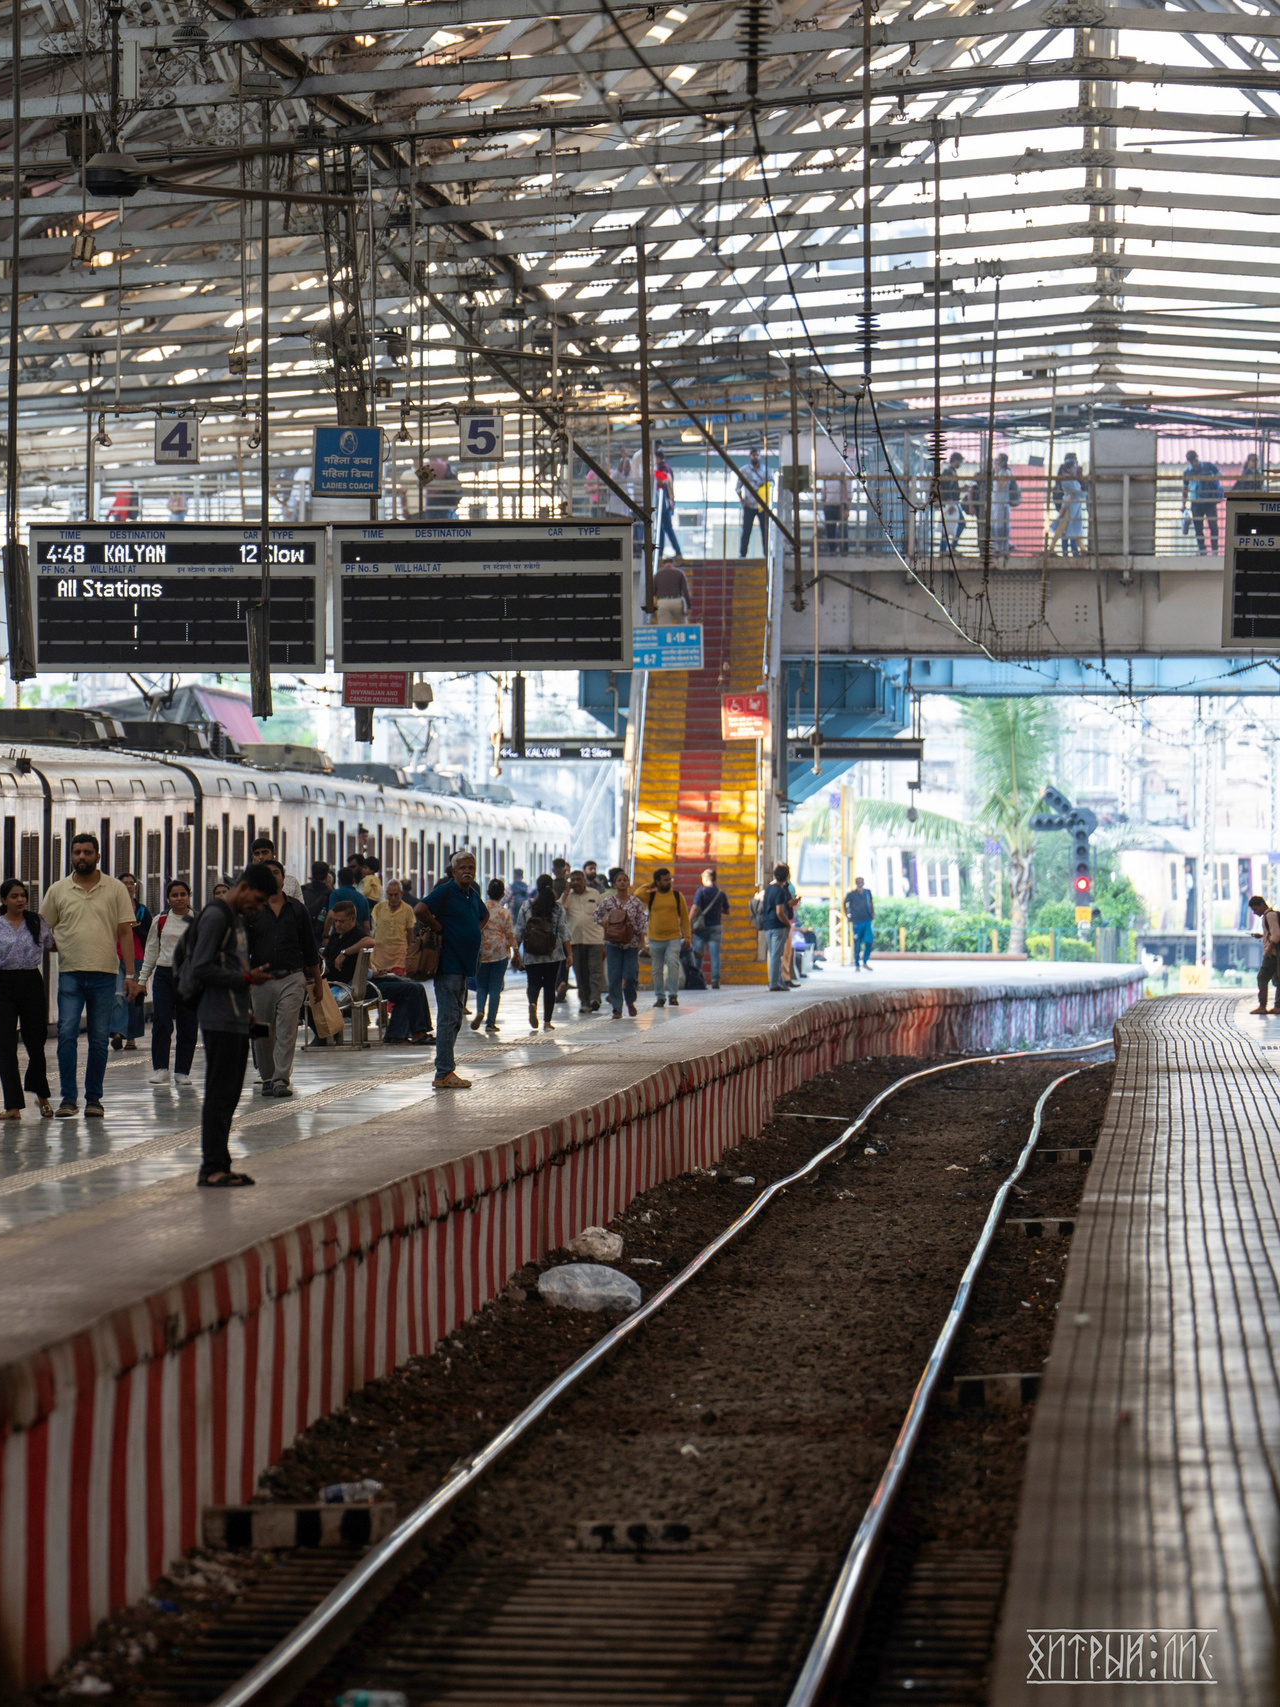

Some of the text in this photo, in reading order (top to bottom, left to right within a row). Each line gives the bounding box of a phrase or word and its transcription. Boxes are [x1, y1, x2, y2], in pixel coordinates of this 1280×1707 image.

[160, 422, 192, 457] 4
[466, 419, 496, 454] 5
[324, 455, 350, 465] महिला
[322, 468, 348, 478] महिला
[60, 531, 294, 539] TIME DESTINATION CAR TYPE
[362, 527, 600, 538] TIME DESTINATION CAR TYPE
[1239, 538, 1250, 546] PF
[46, 544, 86, 563] 4:48
[104, 544, 166, 563] KALYAN
[239, 544, 257, 563] 12
[41, 566, 52, 574] PF
[345, 564, 355, 573] PF
[395, 564, 411, 572] WILL
[413, 564, 430, 572] HALT
[432, 563, 441, 572] AT
[57, 579, 163, 598] All Stations
[525, 748, 561, 757] KALYAN
[580, 748, 591, 757] 12
